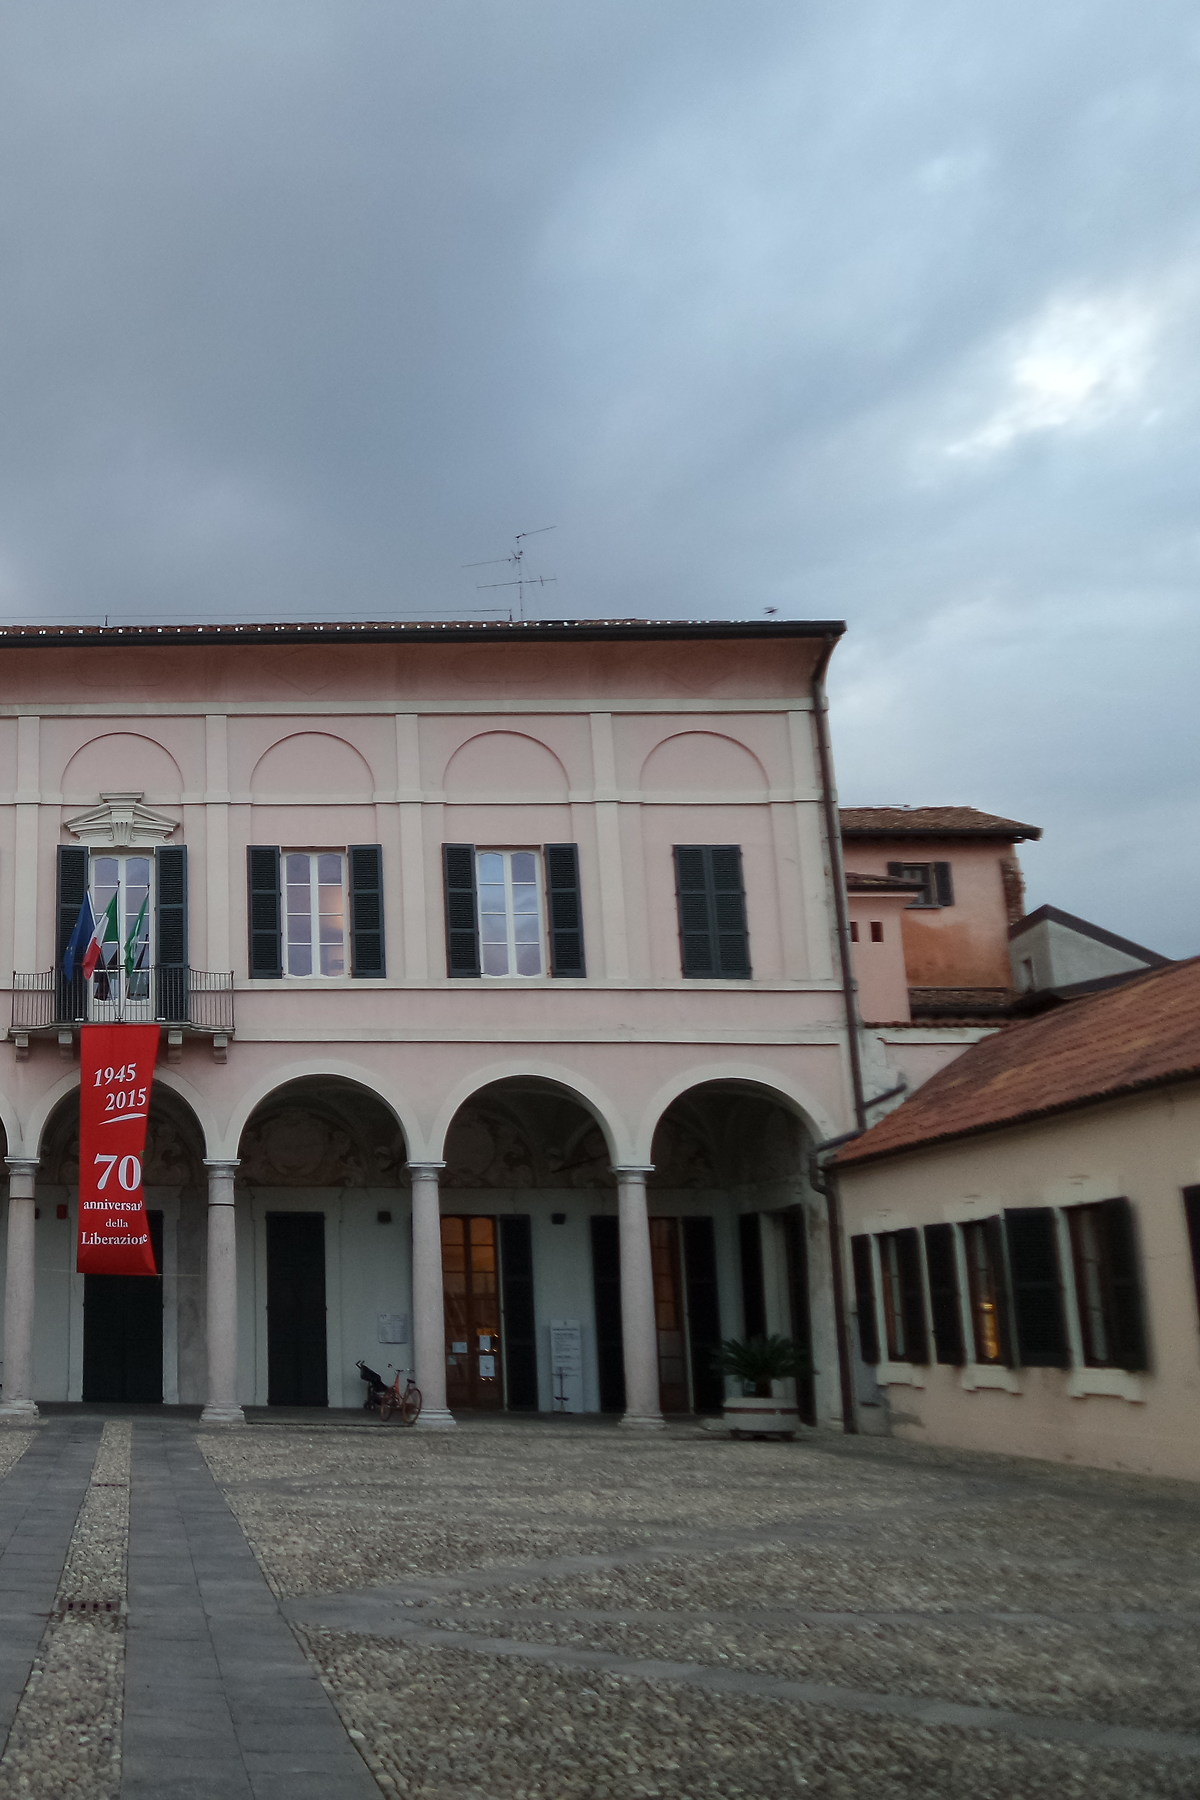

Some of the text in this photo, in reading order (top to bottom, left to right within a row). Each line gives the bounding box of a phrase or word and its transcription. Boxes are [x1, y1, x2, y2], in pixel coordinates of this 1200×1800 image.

[93, 1062, 137, 1087] 1945
[104, 1087, 147, 1111] 2015
[94, 1153, 142, 1191] 70
[105, 1218, 129, 1228] della
